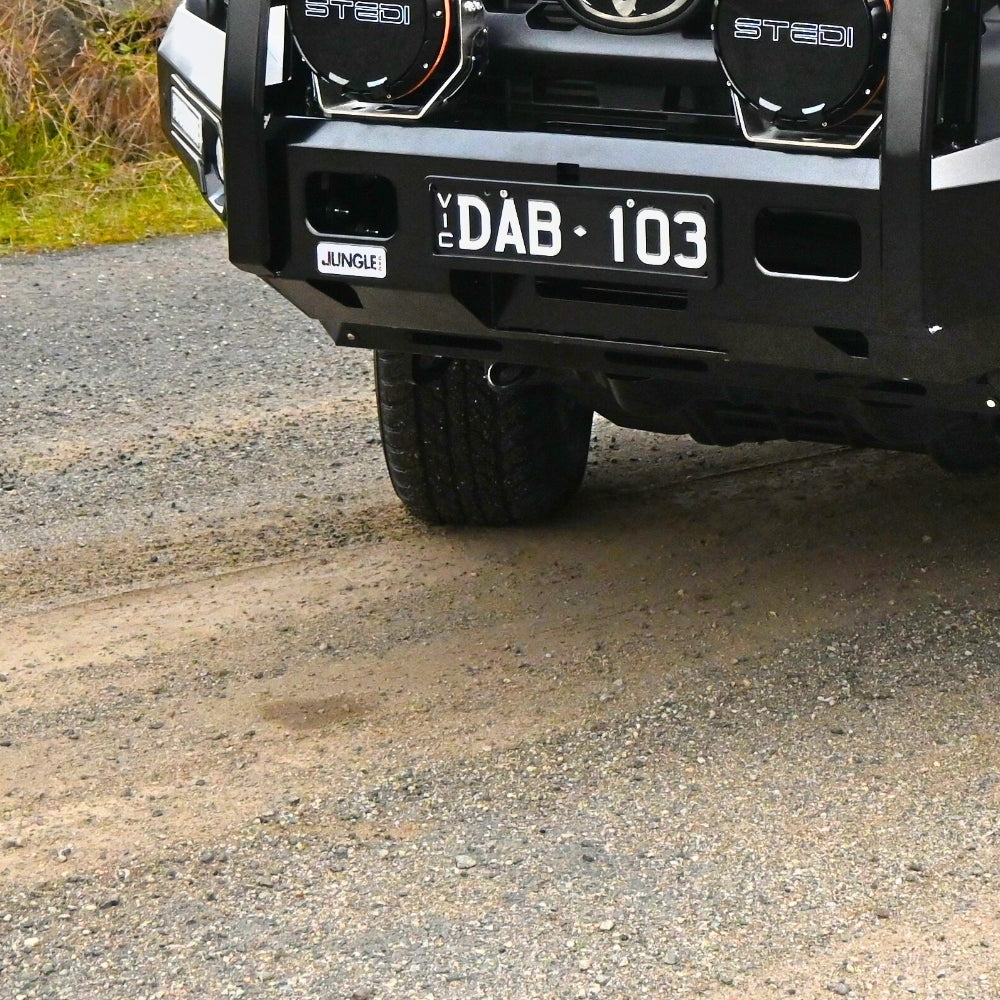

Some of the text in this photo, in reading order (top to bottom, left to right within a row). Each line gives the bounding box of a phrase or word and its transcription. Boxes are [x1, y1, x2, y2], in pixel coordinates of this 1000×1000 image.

[734, 17, 854, 48] STEDI
[437, 193, 454, 248] VIC
[457, 194, 707, 269] DAB 103
[321, 251, 377, 270] JUNGLE
